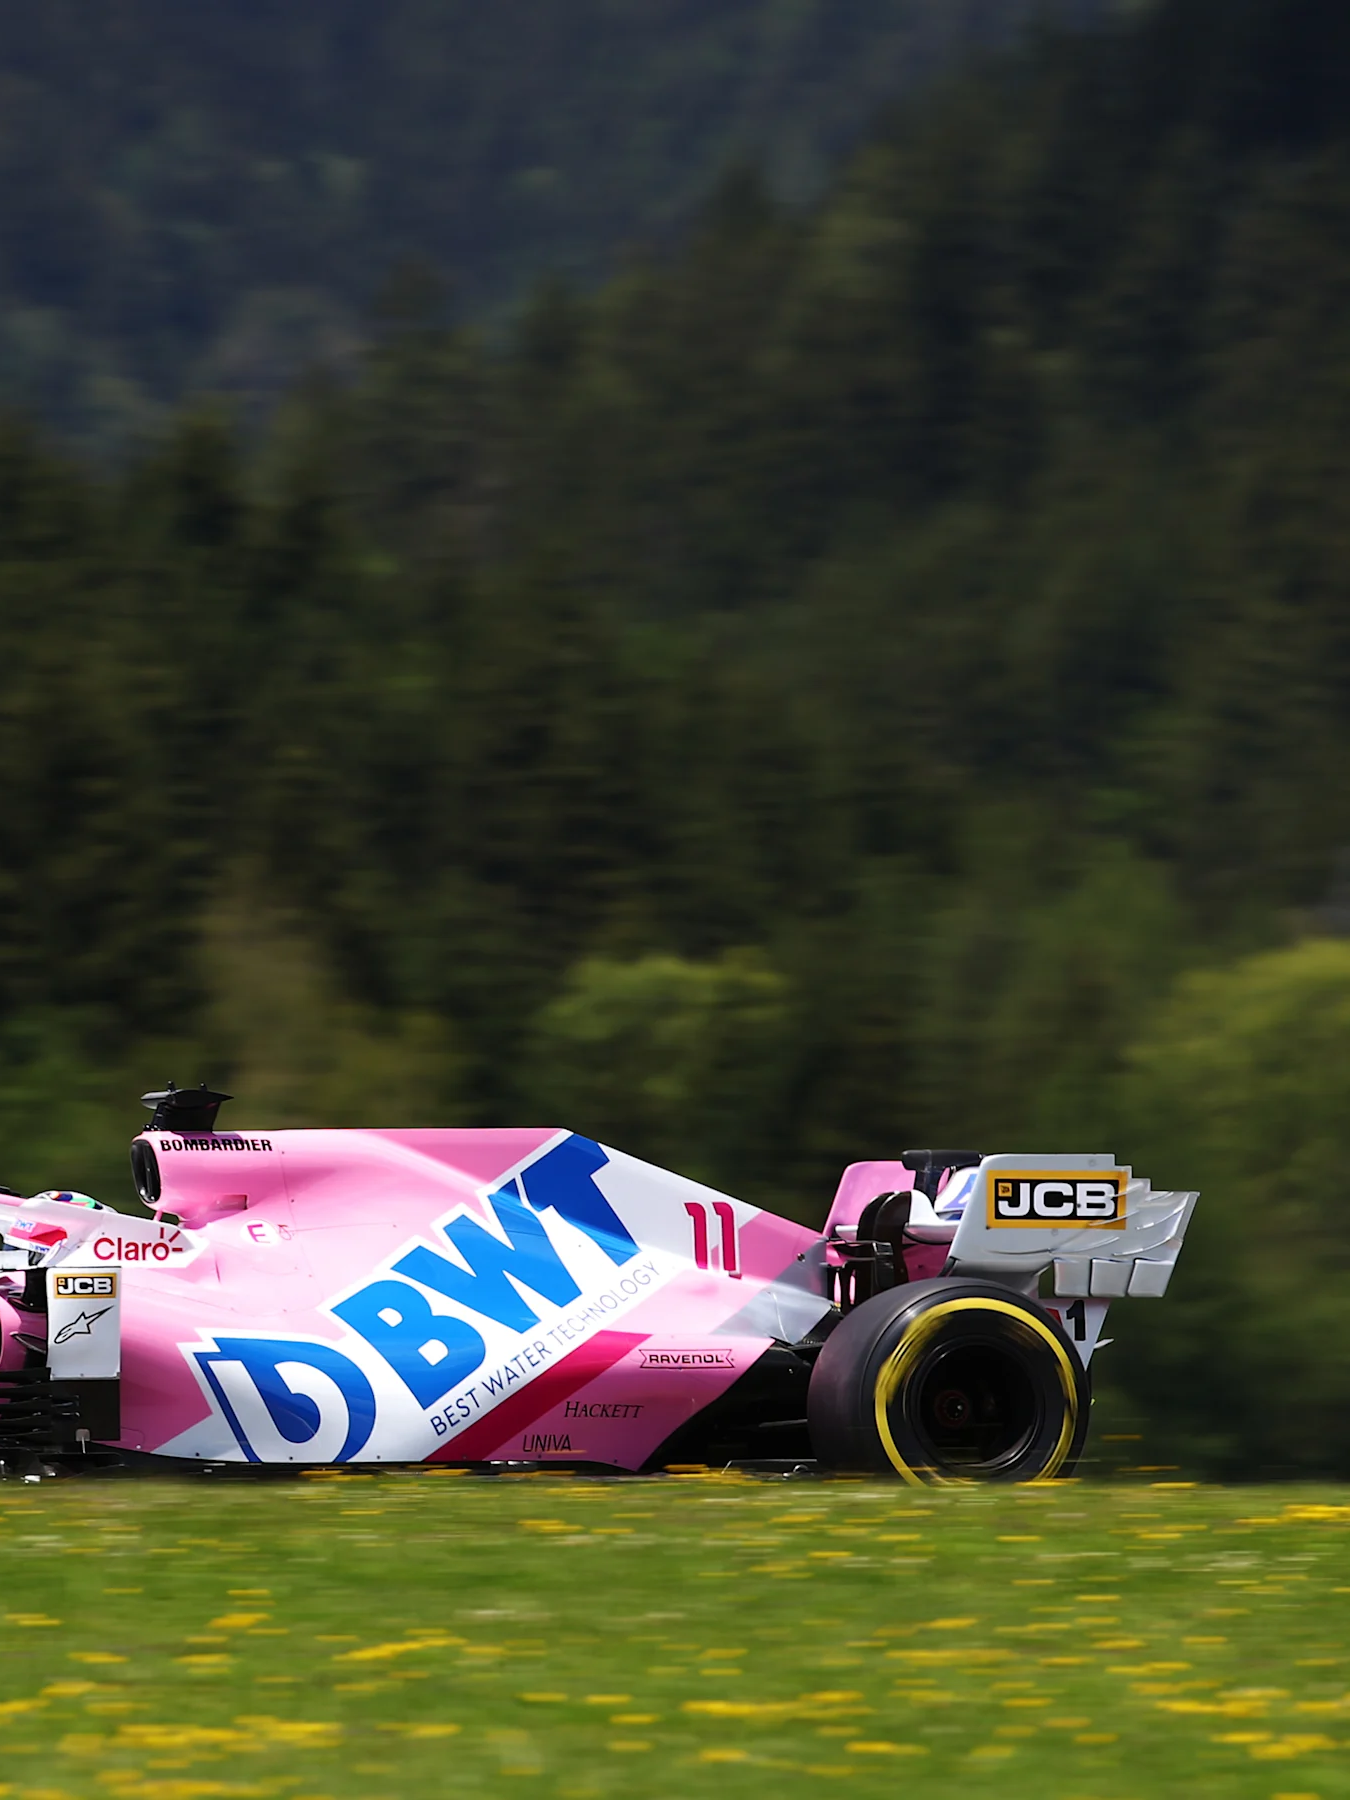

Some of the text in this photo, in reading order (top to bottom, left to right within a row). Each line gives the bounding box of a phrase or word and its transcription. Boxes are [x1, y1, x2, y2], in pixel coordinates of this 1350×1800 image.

[160, 1138, 272, 1151] BOMBARDIER
[998, 1182, 1116, 1217] JCB
[93, 1237, 170, 1261] Claro
[684, 1202, 740, 1279] 11
[330, 1133, 642, 1410] BWT
[58, 1278, 112, 1294] JCB
[430, 1261, 660, 1436] BEST WATER TECHNOLOGY
[649, 1354, 724, 1364] RAVENOL
[564, 1401, 644, 1418] HACKETT
[523, 1434, 572, 1452] UNIVA
